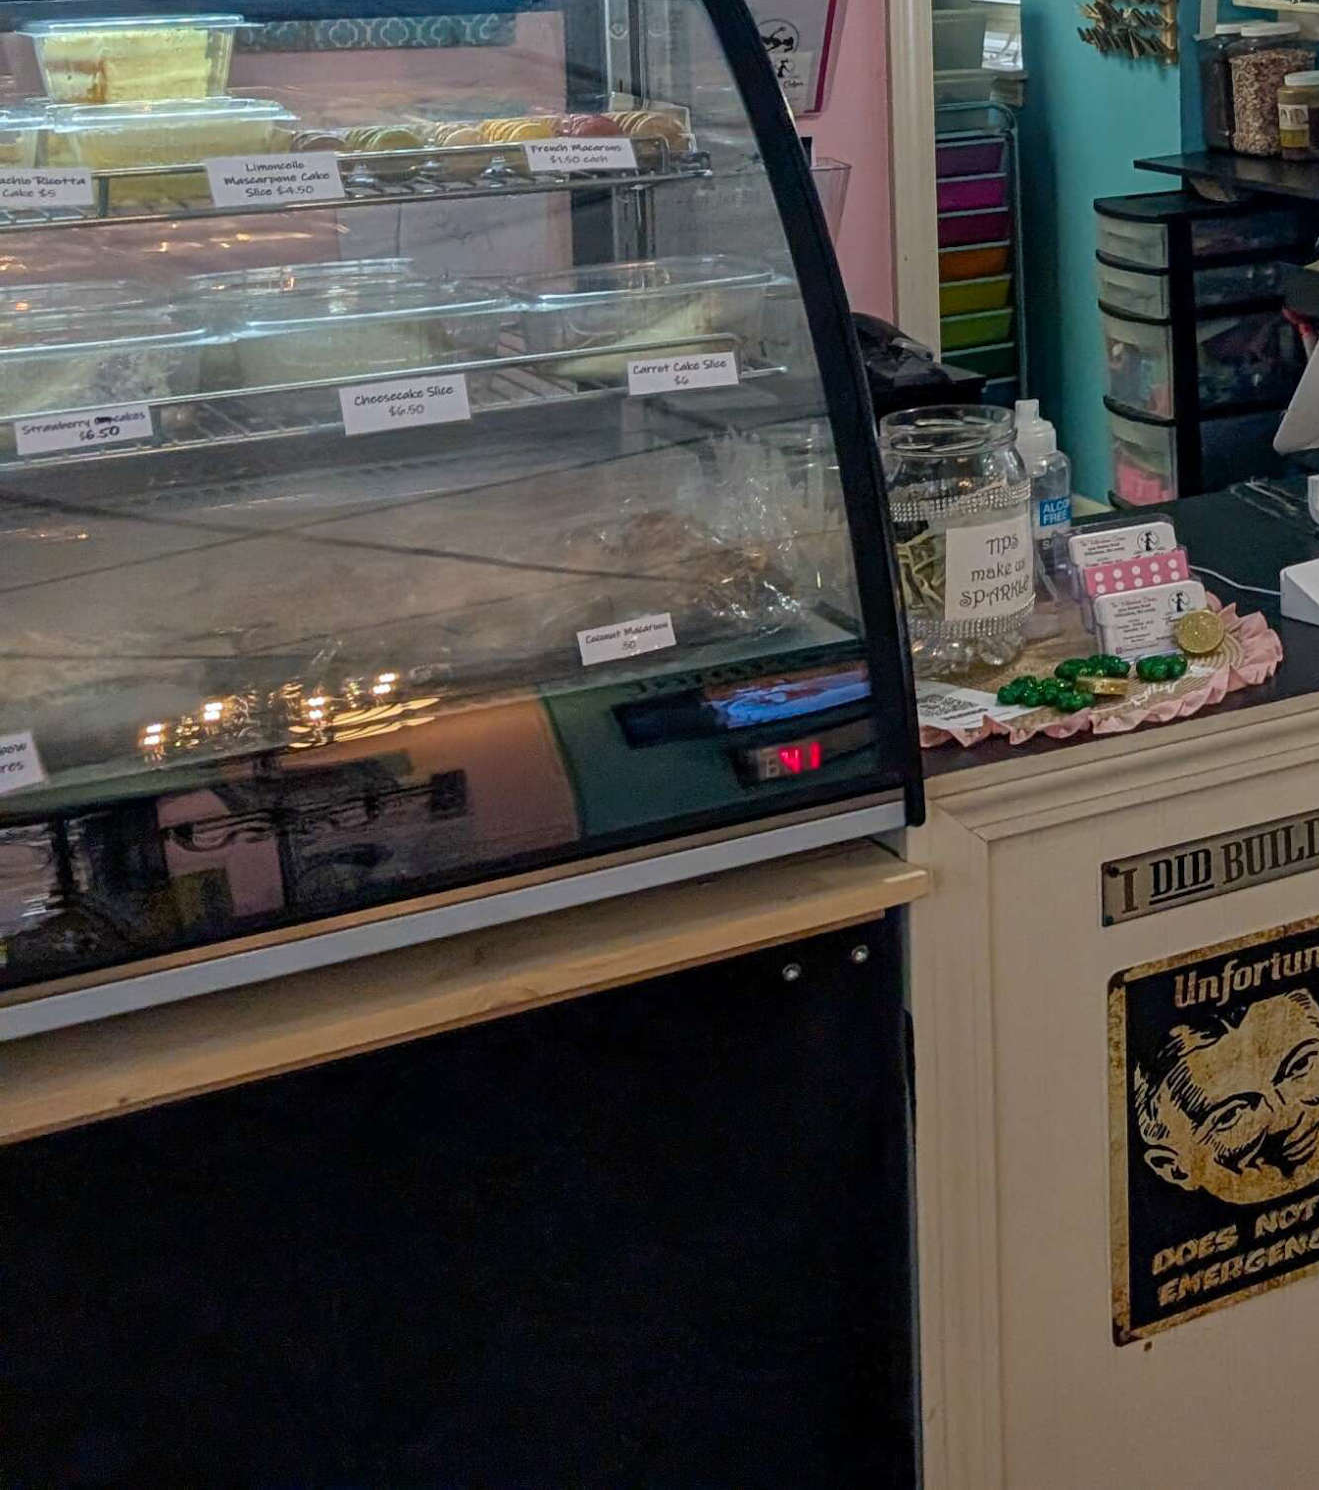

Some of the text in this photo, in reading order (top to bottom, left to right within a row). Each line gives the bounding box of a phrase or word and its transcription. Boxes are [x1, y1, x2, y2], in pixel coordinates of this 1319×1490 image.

[530, 145, 568, 153] French
[245, 161, 305, 172] Limoncello
[36, 175, 86, 186] Ricotta
[224, 171, 330, 187] Mascarpone Cake
[245, 186, 273, 198] Slice
[633, 359, 727, 375] Carrot Cake Slice
[354, 385, 454, 406] Cheesecake Slice
[21, 419, 90, 435] Strawberry
[1042, 512, 1069, 525] FREE
[971, 562, 1012, 582] make
[1121, 867, 1139, 914] I
[1149, 848, 1213, 900] DID
[1152, 1225, 1239, 1276] DOES
